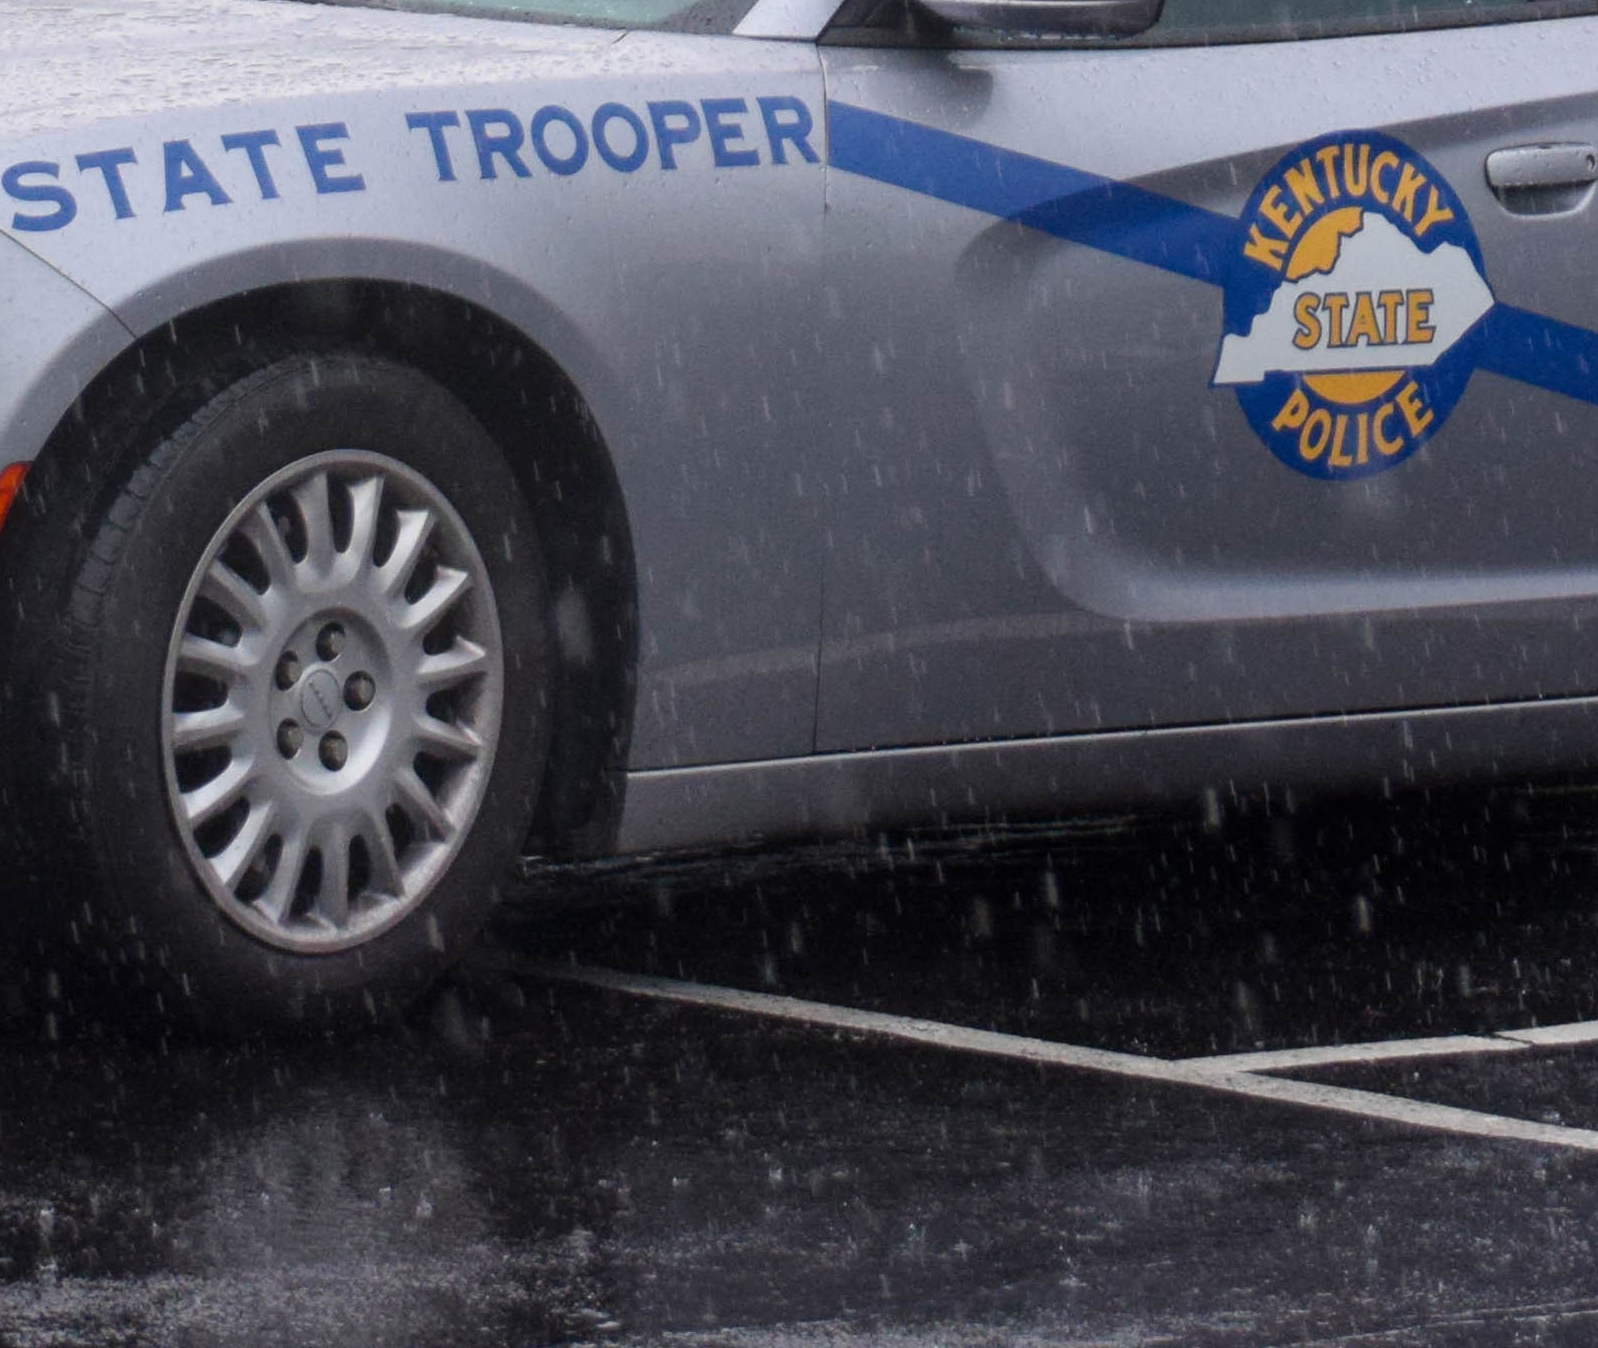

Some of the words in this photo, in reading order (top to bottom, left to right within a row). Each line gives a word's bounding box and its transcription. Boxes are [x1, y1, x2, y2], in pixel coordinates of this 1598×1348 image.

[1, 122, 365, 233] STATE
[405, 96, 822, 182] TROOPER
[1243, 143, 1454, 272] KENTUCKY
[1292, 288, 1436, 350] STATE
[1271, 381, 1435, 467] POLICE
